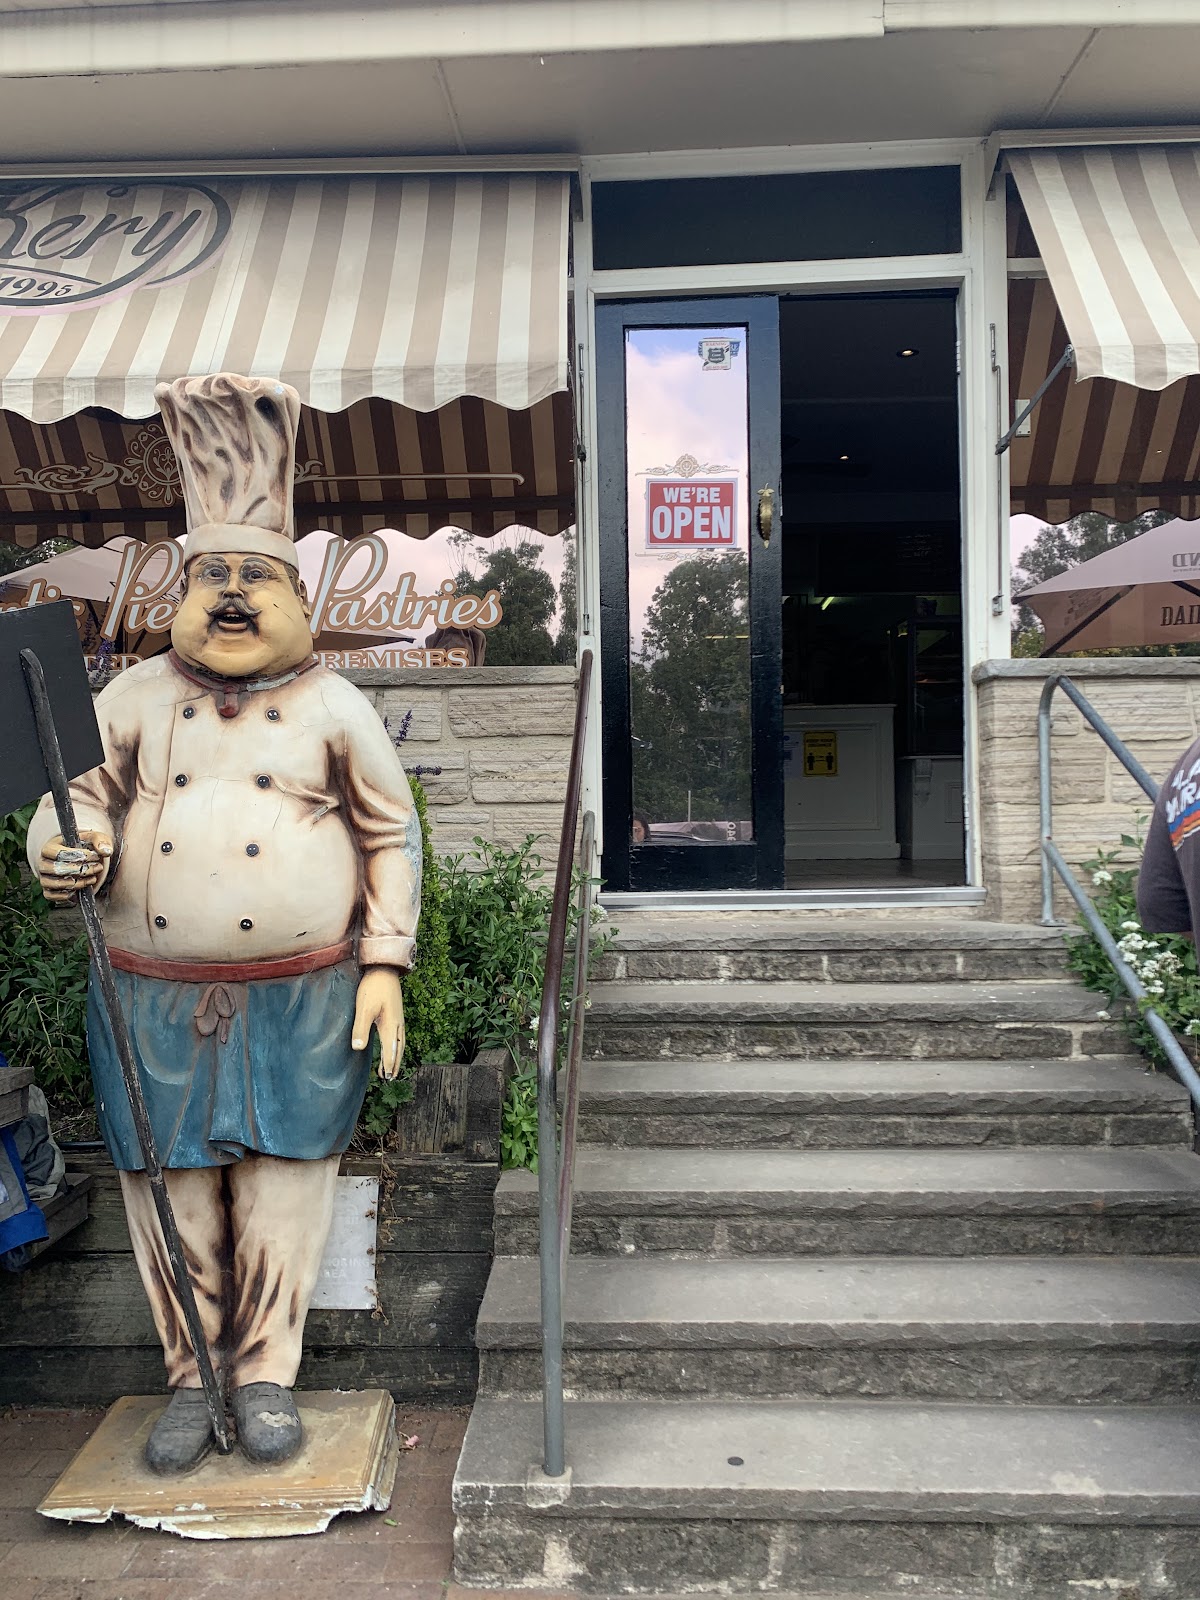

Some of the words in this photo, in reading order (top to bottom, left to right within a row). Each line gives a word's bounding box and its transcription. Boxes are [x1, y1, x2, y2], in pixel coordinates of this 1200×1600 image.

[0, 276, 73, 298] 1995
[662, 486, 721, 504] WE'RE
[652, 505, 731, 540] OPEN
[309, 534, 503, 639] Pastries
